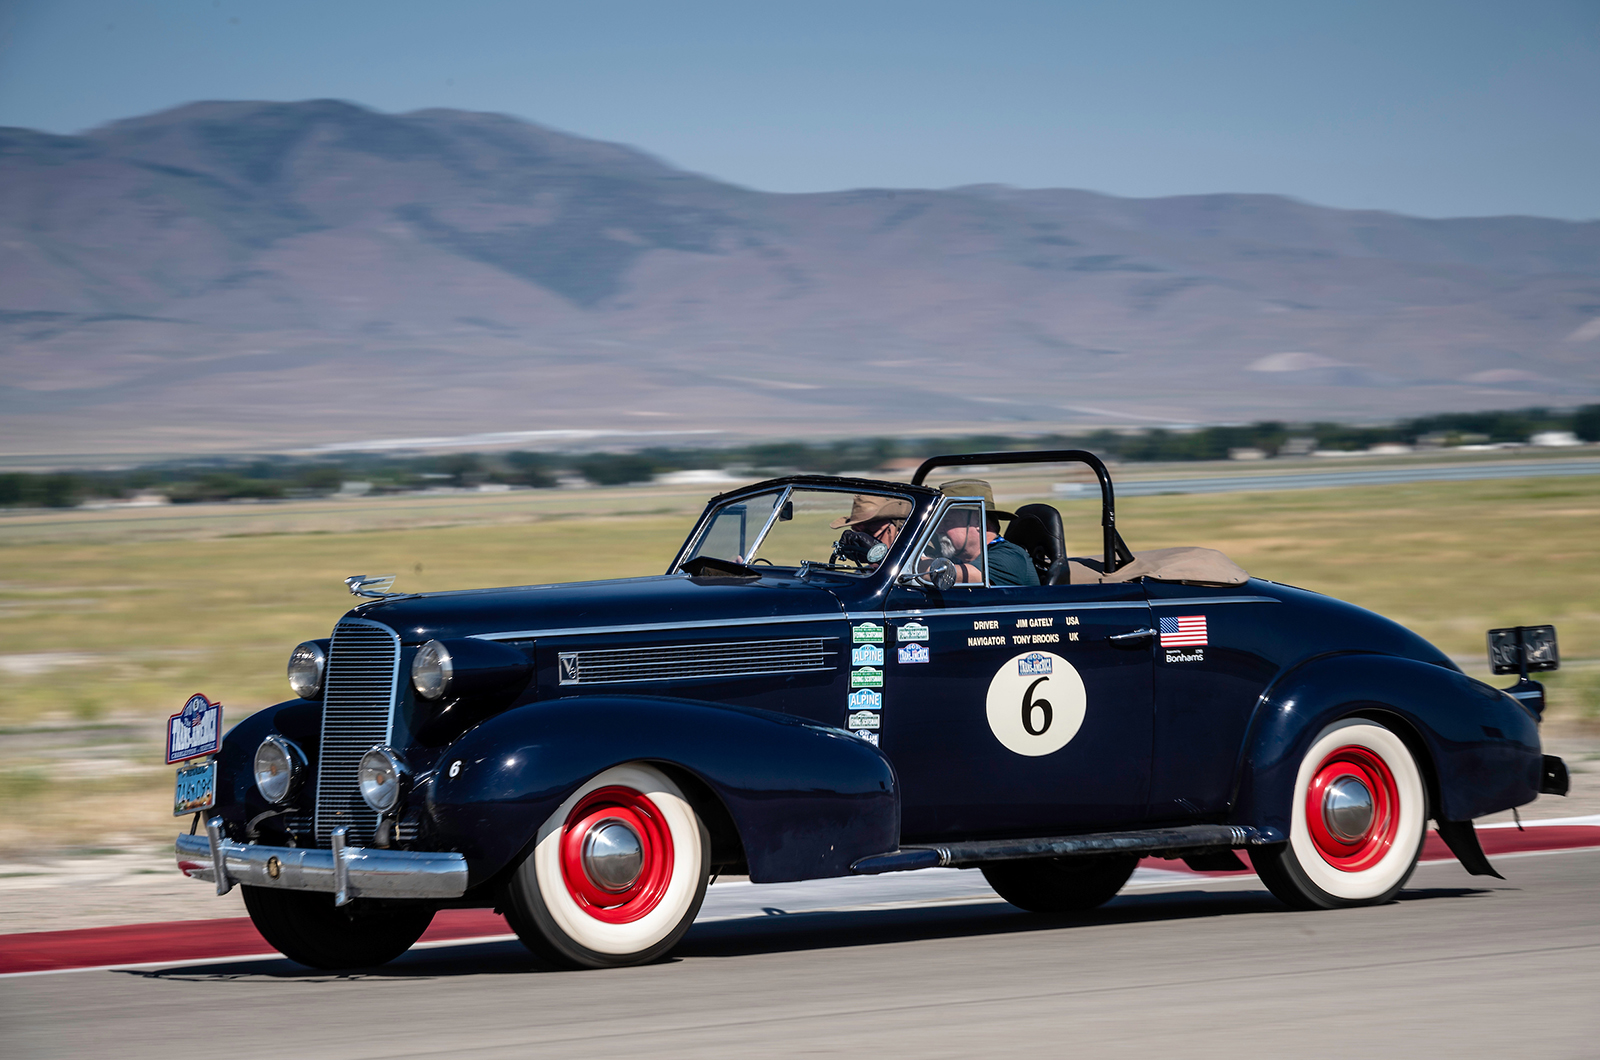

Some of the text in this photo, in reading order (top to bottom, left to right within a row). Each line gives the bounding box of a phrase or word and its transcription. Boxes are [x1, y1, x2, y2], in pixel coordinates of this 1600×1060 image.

[974, 616, 1079, 630] DRIVER JIM GATELY USA
[967, 632, 1079, 646] NAVIGATOR TONY BROOKS UK
[854, 650, 882, 663] ALPINE
[1166, 653, 1204, 663] Bonhams
[850, 694, 880, 707] ALPINE
[1021, 676, 1053, 736] 6
[449, 760, 462, 778] 6
